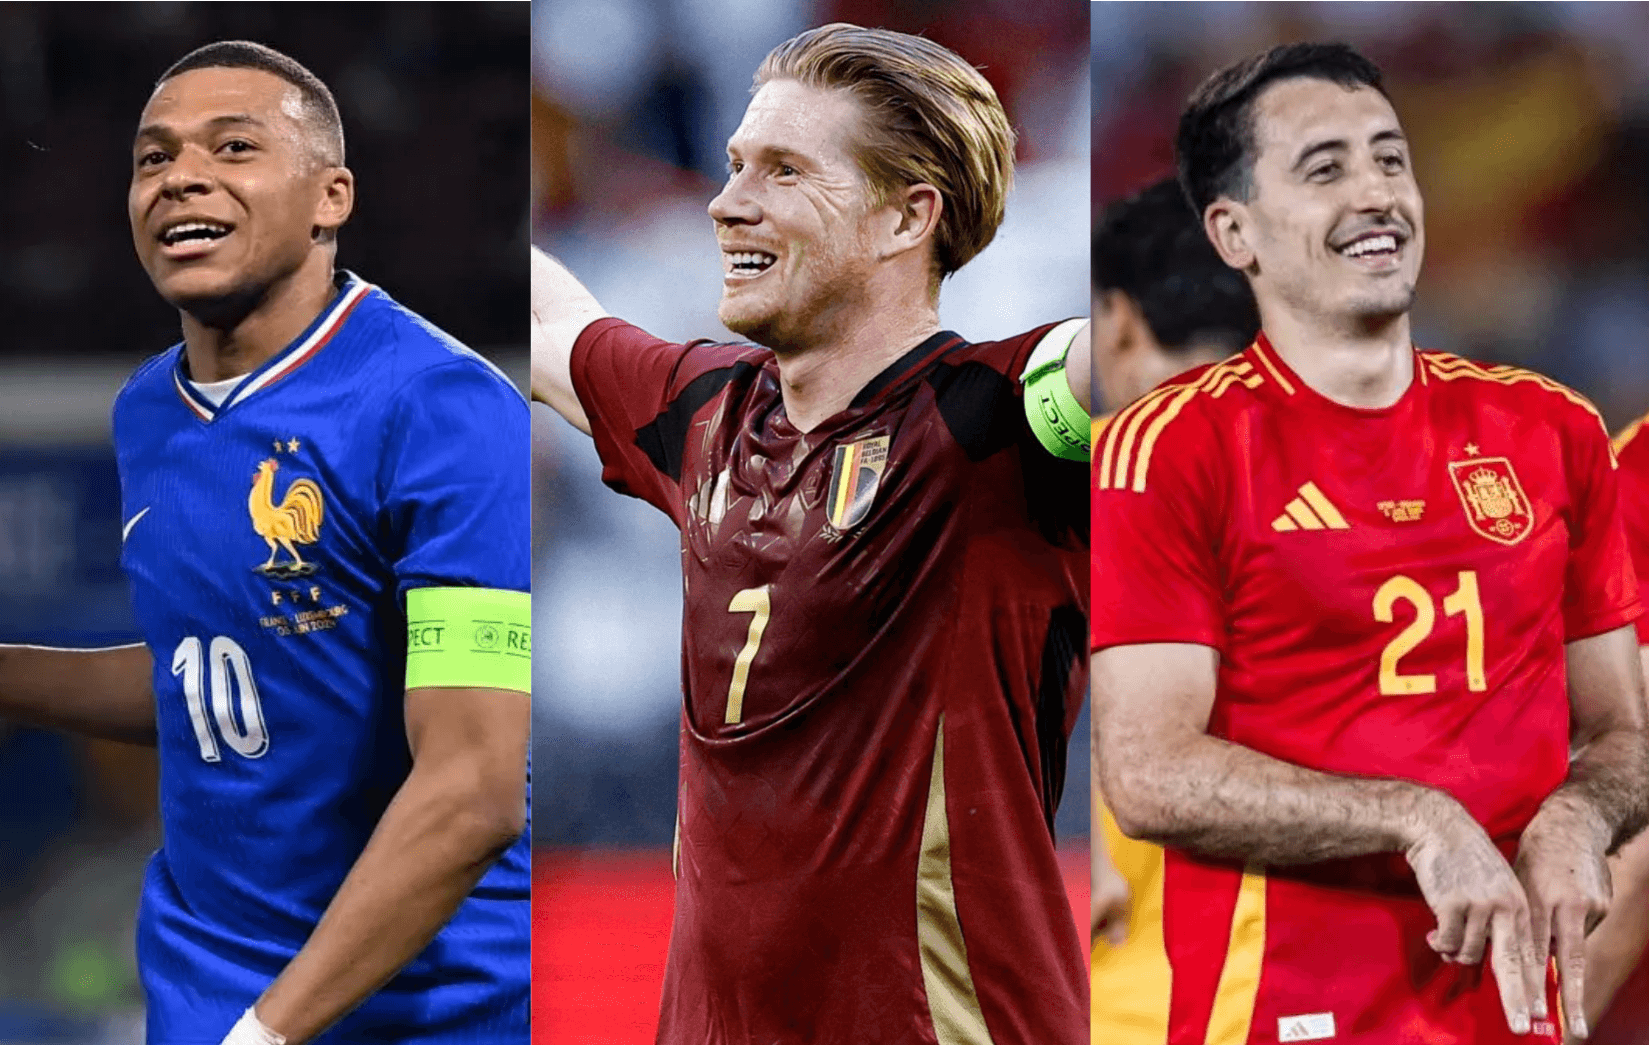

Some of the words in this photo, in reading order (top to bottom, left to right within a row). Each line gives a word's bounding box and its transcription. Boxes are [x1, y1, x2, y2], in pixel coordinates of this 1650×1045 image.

[507, 630, 531, 653] RE
[725, 584, 771, 724] 7
[1372, 571, 1487, 696] 21
[171, 635, 269, 763] 10
